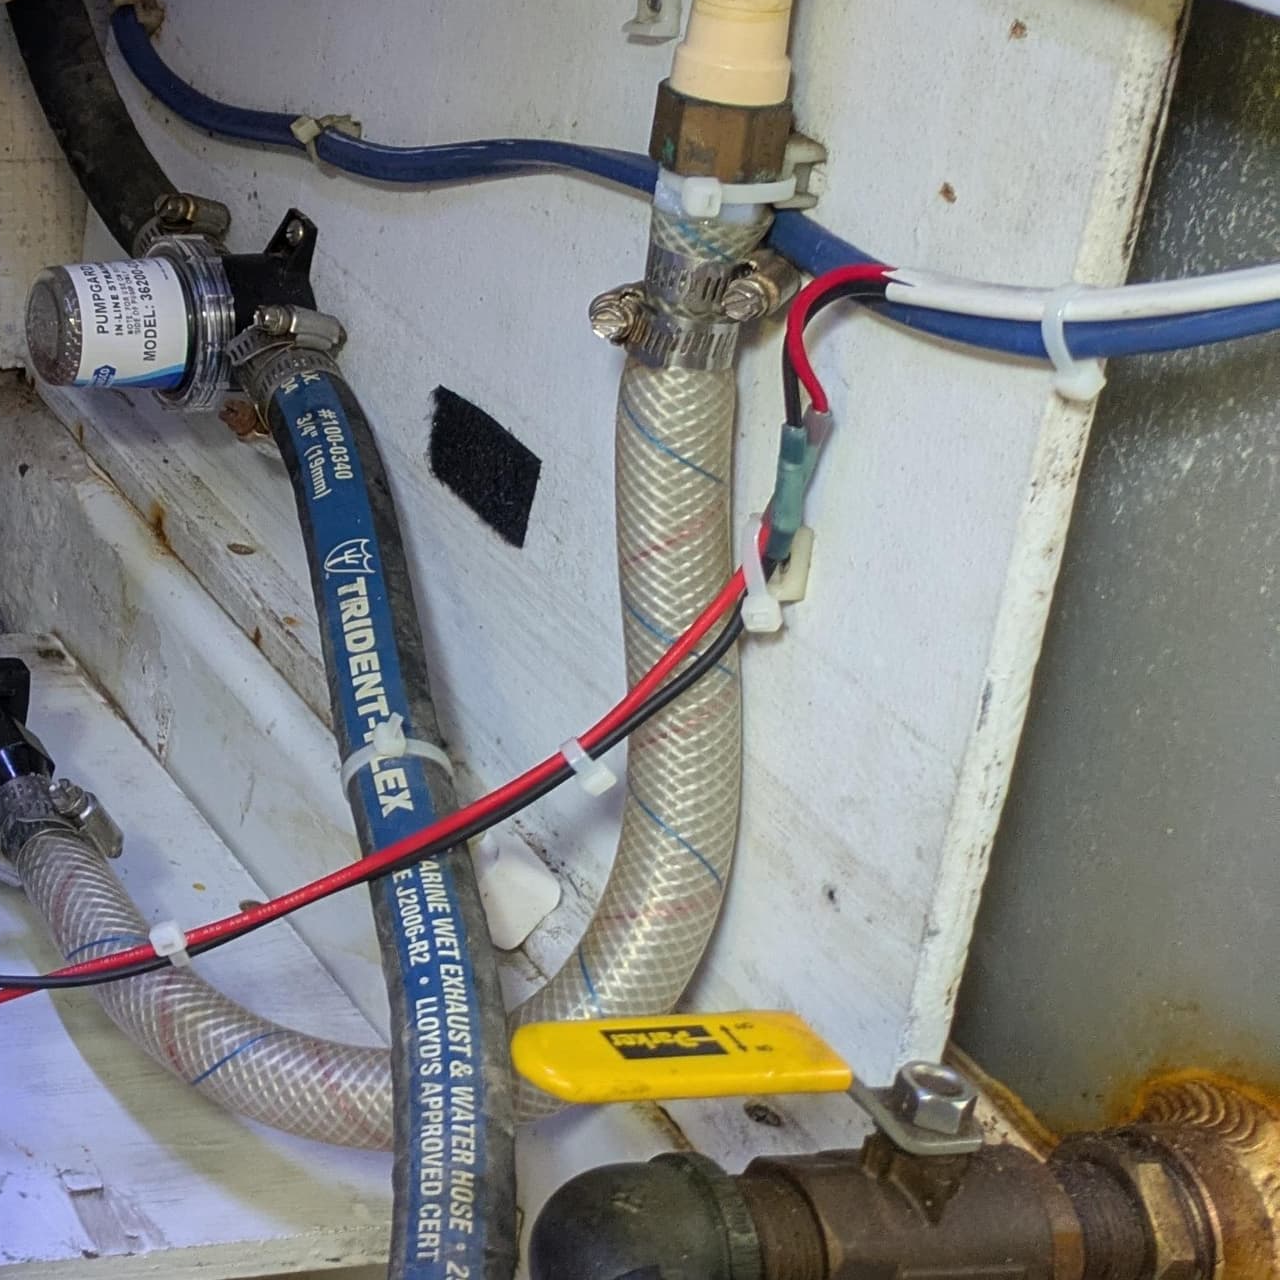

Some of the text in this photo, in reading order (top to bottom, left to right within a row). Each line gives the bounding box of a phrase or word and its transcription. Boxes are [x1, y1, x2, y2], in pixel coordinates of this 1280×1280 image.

[80, 266, 109, 334] PUMPGARD
[111, 295, 123, 335] IN-LINE
[143, 305, 157, 361] MODEL:
[303, 445, 331, 499] (19mm)
[319, 408, 353, 480] #100-0340
[336, 577, 413, 818] TRIDENT-LEX
[418, 855, 452, 914] ARINE
[395, 886, 430, 966] J2006-R2
[435, 917, 461, 958] WET
[415, 997, 440, 1075] LLOYD'S
[439, 963, 471, 1055] EXHAUST
[610, 1031, 717, 1050] Parker
[449, 1060, 471, 1077] &
[417, 1082, 442, 1196] APPROVED
[450, 1086, 475, 1163] WATER
[417, 1204, 440, 1262] CERT
[447, 1170, 475, 1233] HOSE
